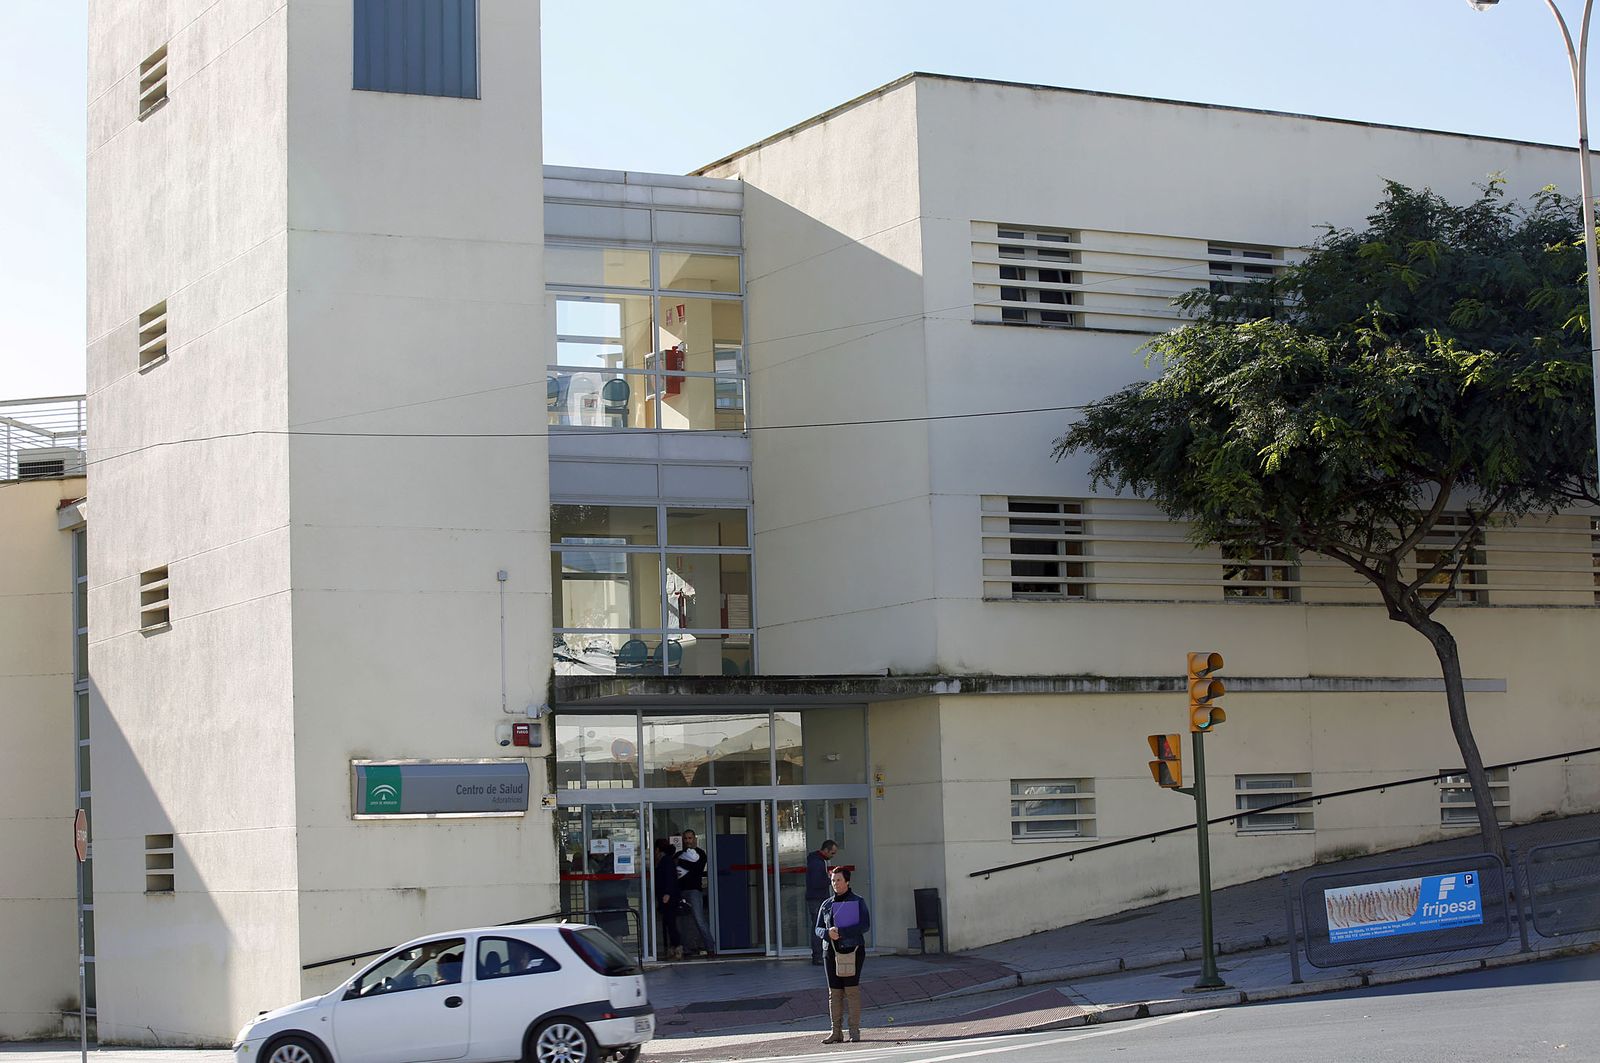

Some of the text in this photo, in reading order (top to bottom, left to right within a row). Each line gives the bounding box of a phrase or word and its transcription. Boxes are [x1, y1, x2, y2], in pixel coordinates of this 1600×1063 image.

[456, 783, 523, 795] Centro de Salud
[1422, 900, 1477, 918] fripesa
